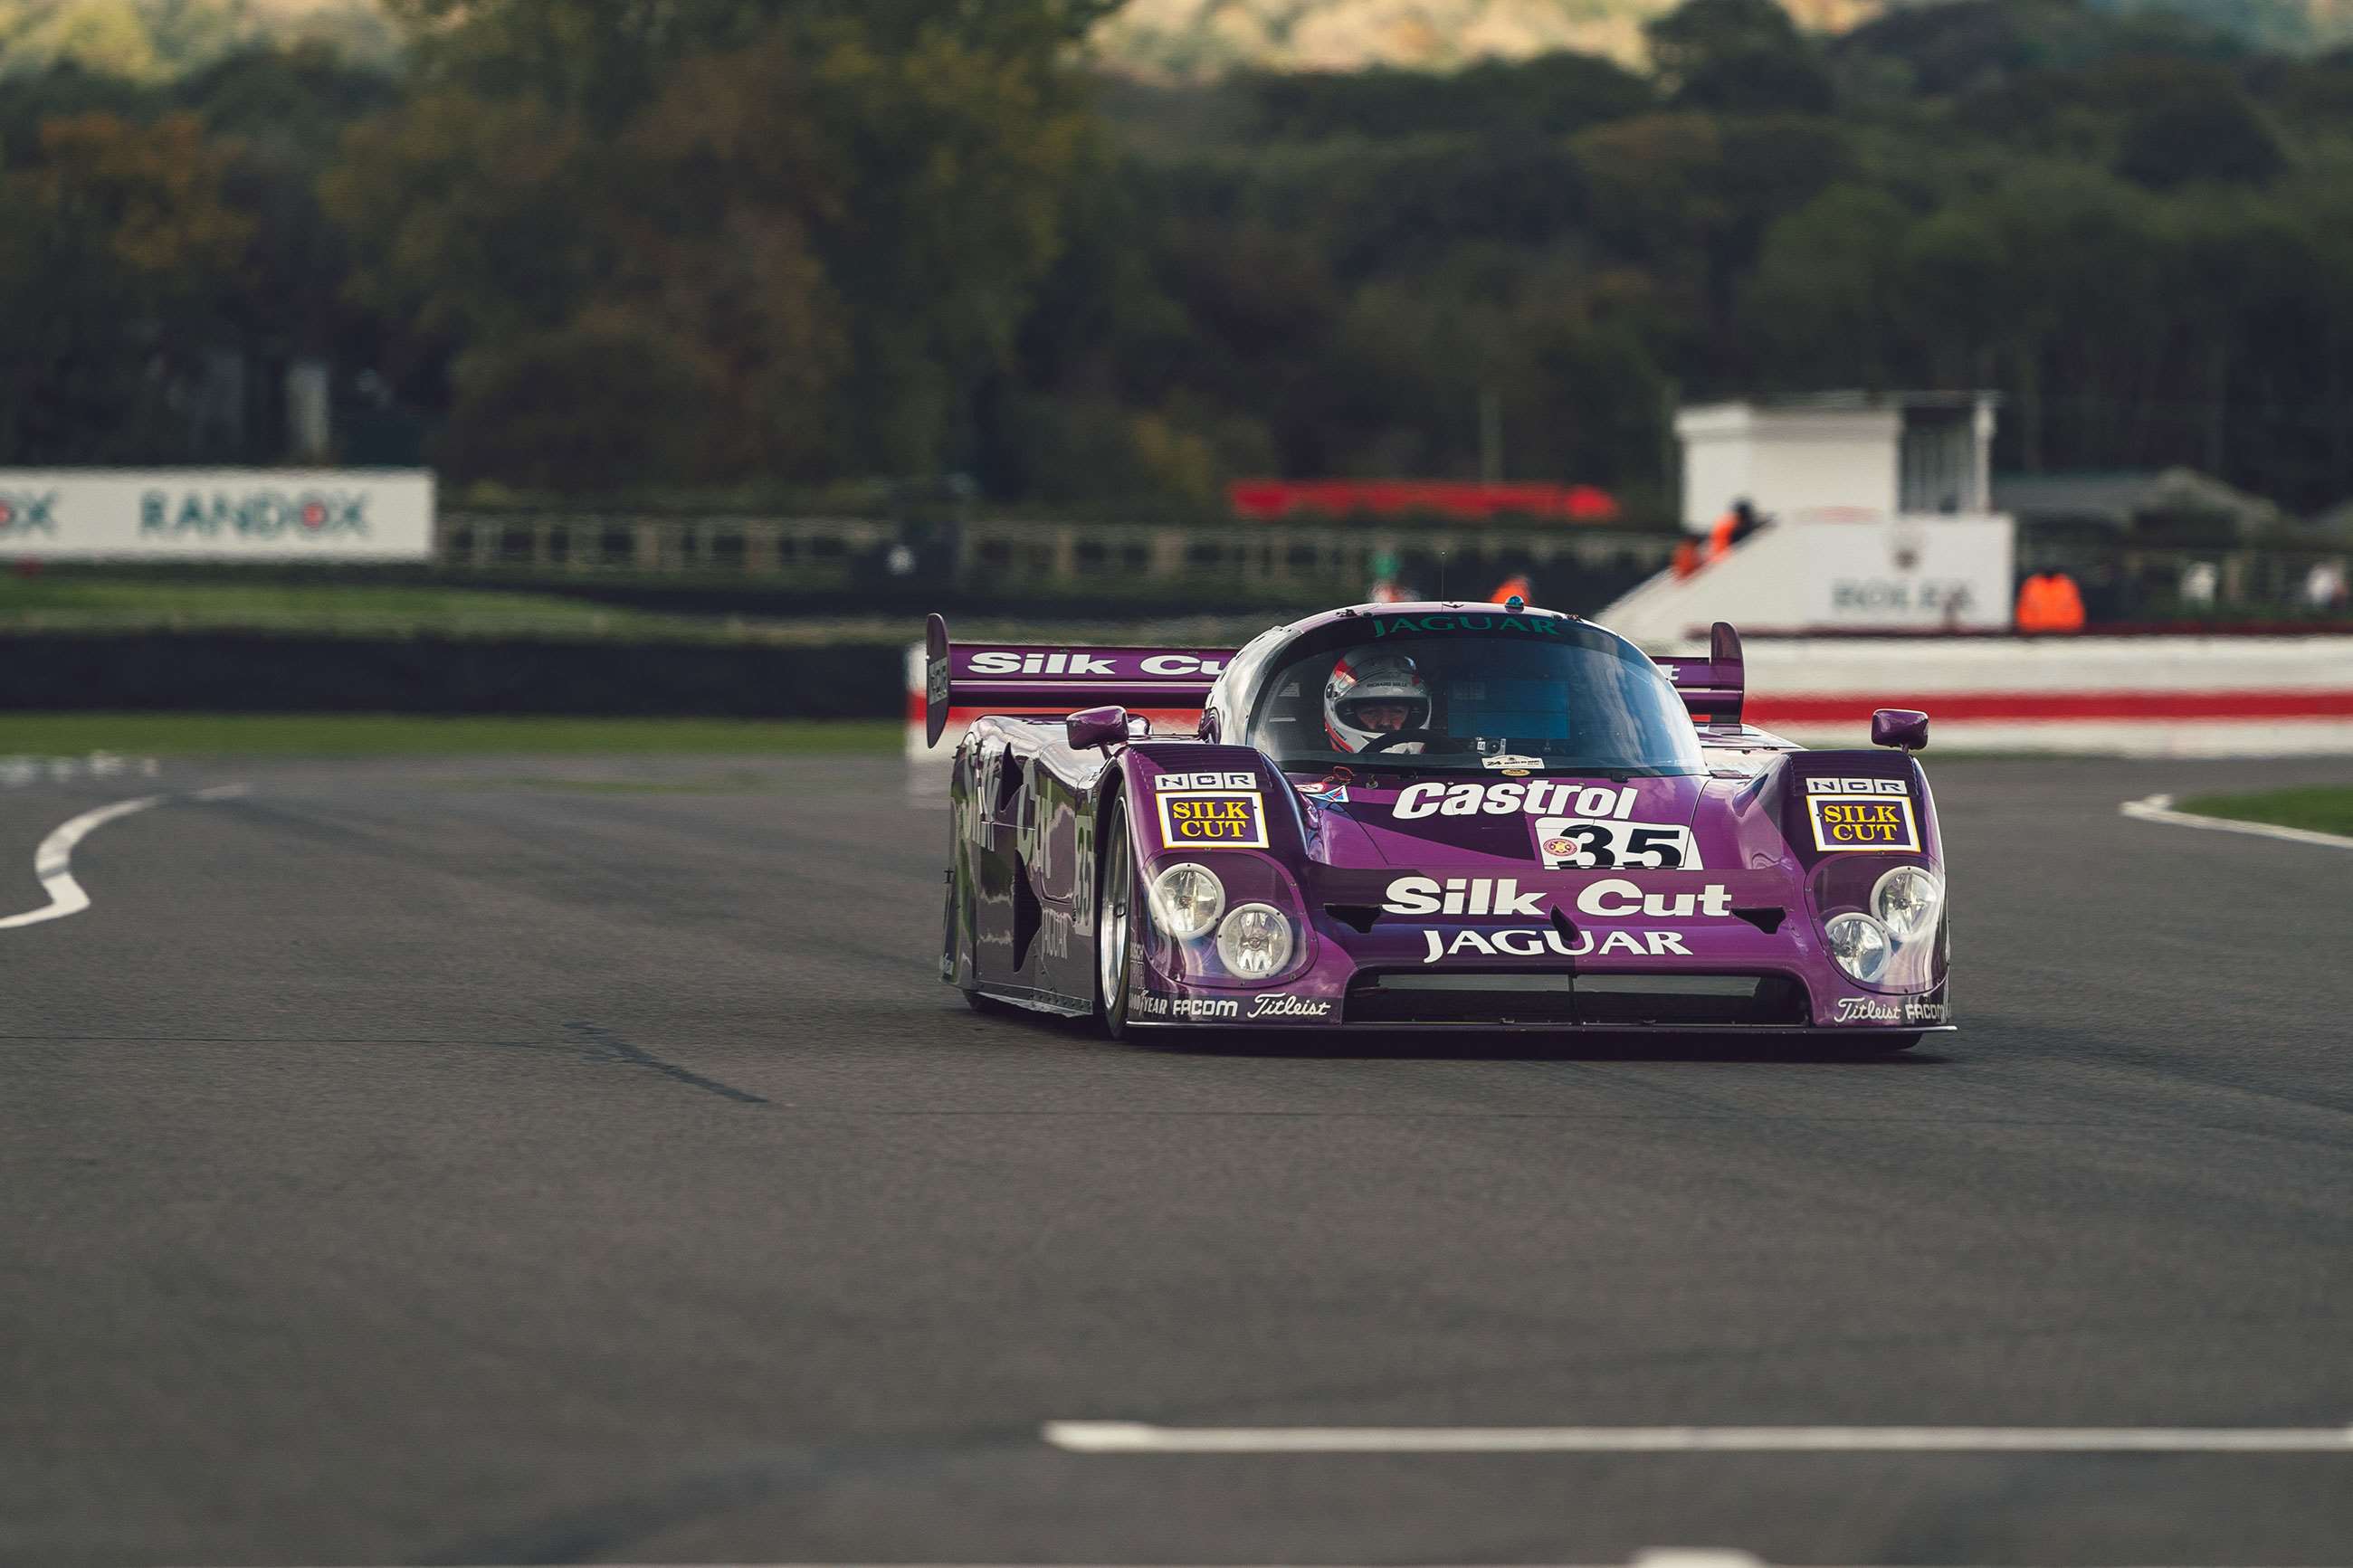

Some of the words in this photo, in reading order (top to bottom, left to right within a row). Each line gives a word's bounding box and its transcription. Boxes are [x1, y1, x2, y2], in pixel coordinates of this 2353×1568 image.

[140, 492, 369, 537] RANDOX
[1373, 616, 1559, 638] JAGUAR
[967, 651, 1118, 674] Silk
[1161, 774, 1251, 786] NCR
[1813, 781, 1901, 792] NCR
[1172, 801, 1250, 819] SILK
[1392, 779, 1639, 820] Castrol
[1824, 804, 1900, 823] SILK
[1180, 820, 1246, 838] CUT
[1833, 823, 1898, 841] CUT
[1557, 824, 1682, 870] 35
[1381, 876, 1548, 916] Silk
[1577, 878, 1733, 917] Cut
[1423, 929, 1694, 964] JAGUAR
[1173, 999, 1239, 1017] FACOM
[1247, 993, 1331, 1018] Titleist
[1834, 997, 1901, 1022] Titleist
